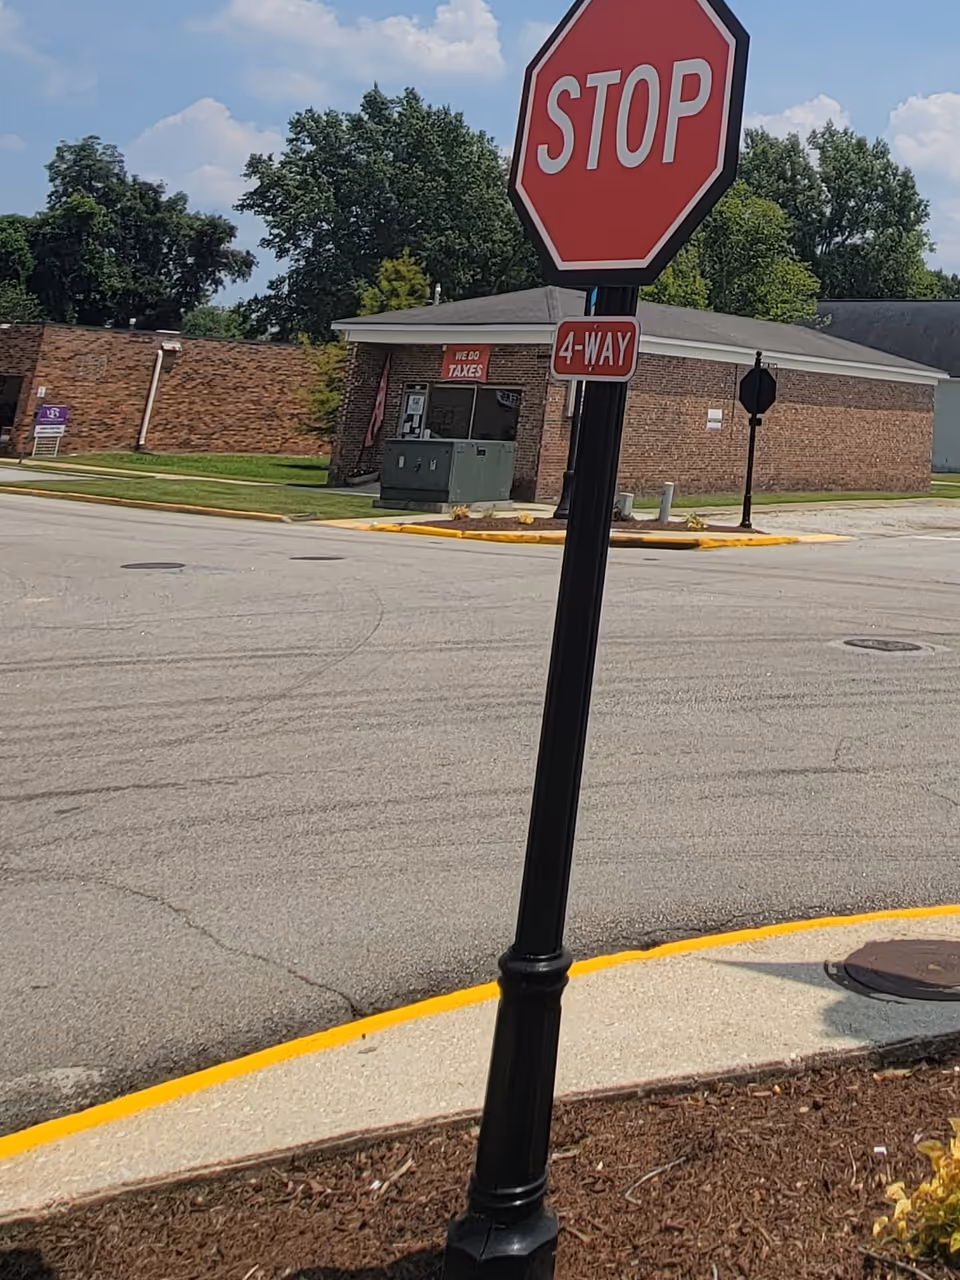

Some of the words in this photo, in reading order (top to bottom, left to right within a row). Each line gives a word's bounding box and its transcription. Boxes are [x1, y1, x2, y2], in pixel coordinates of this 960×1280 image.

[537, 57, 713, 175] STOP
[455, 351, 468, 360] WE
[467, 351, 480, 360] DO
[558, 331, 632, 367] 4-WAY
[448, 364, 483, 377] TAXES
